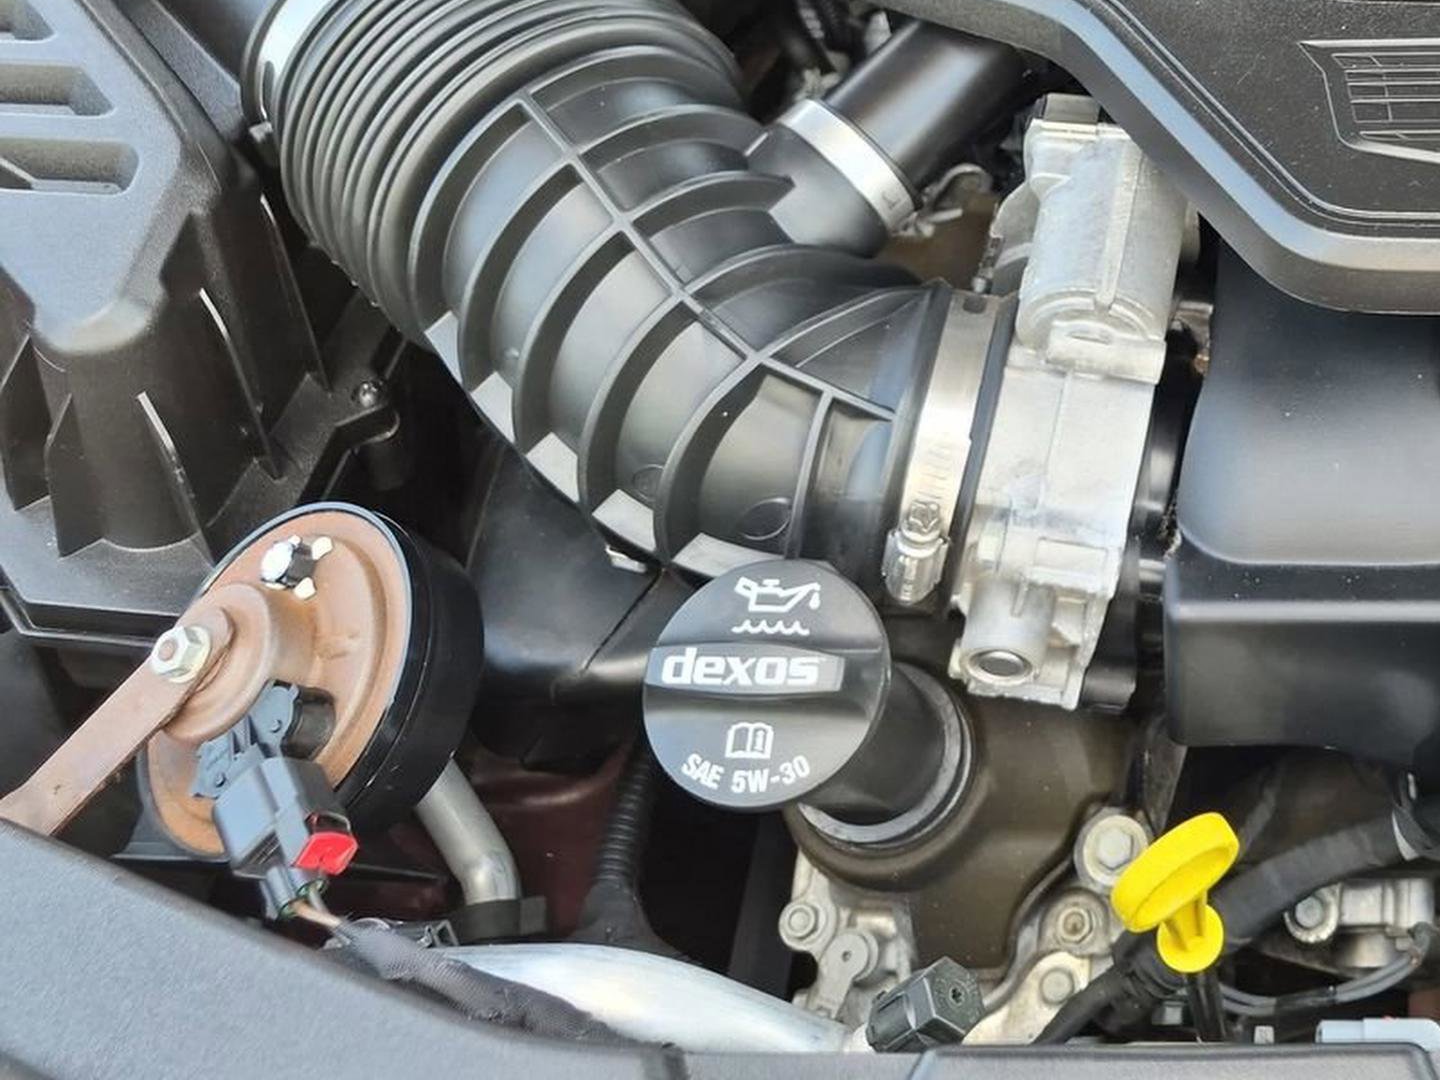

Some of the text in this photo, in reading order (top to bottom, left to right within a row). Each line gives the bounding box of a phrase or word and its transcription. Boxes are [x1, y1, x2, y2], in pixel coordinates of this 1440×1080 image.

[661, 647, 821, 686] dexos
[681, 753, 811, 794] SAE 5W-30
